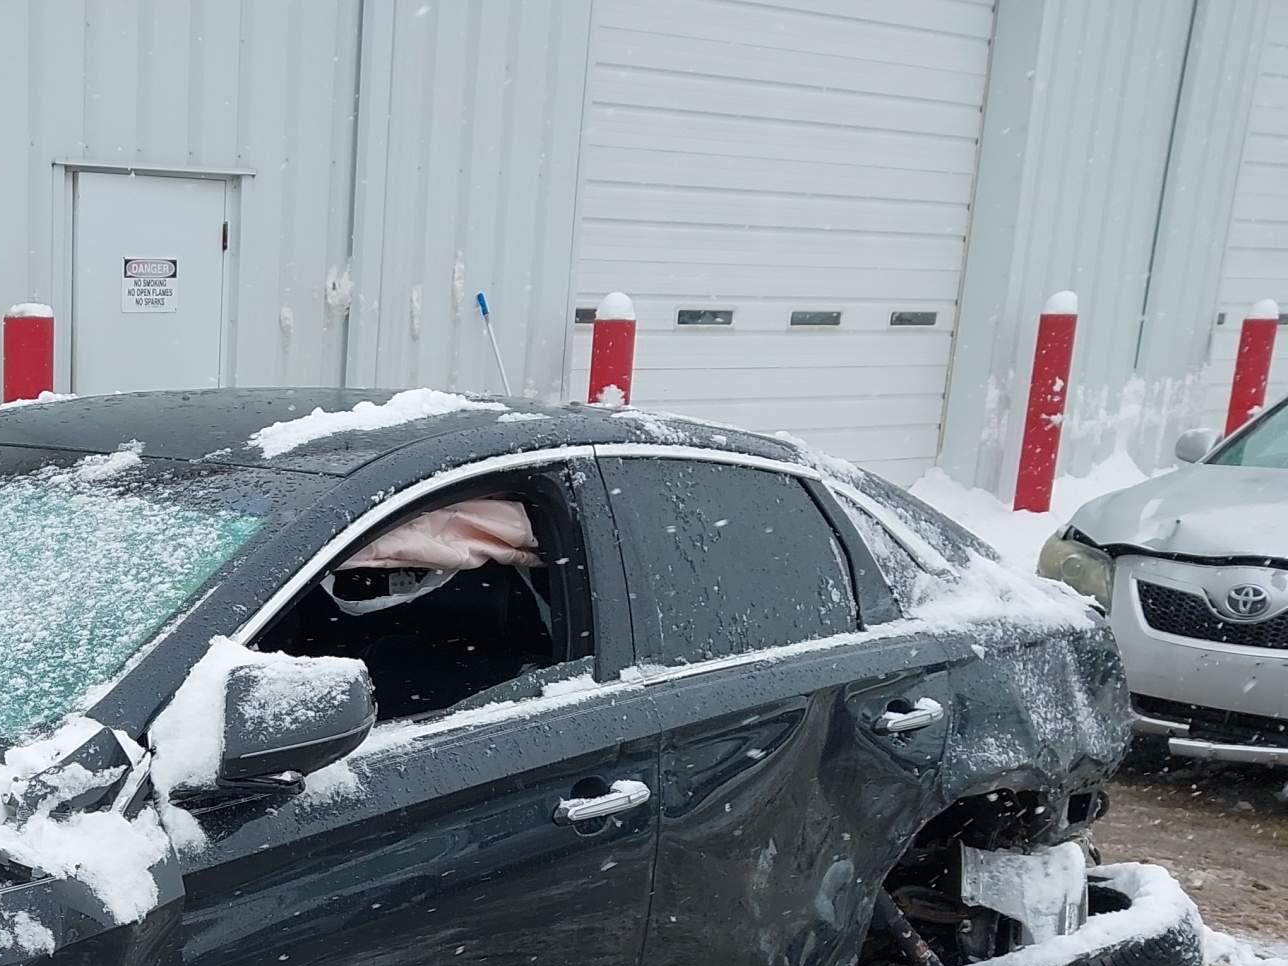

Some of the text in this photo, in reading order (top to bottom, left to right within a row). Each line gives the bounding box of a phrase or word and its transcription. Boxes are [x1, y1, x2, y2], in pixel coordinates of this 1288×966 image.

[132, 263, 169, 273] DANGER
[134, 279, 167, 287] NO SMOKING
[128, 288, 173, 296] NO OPEN FLAMES
